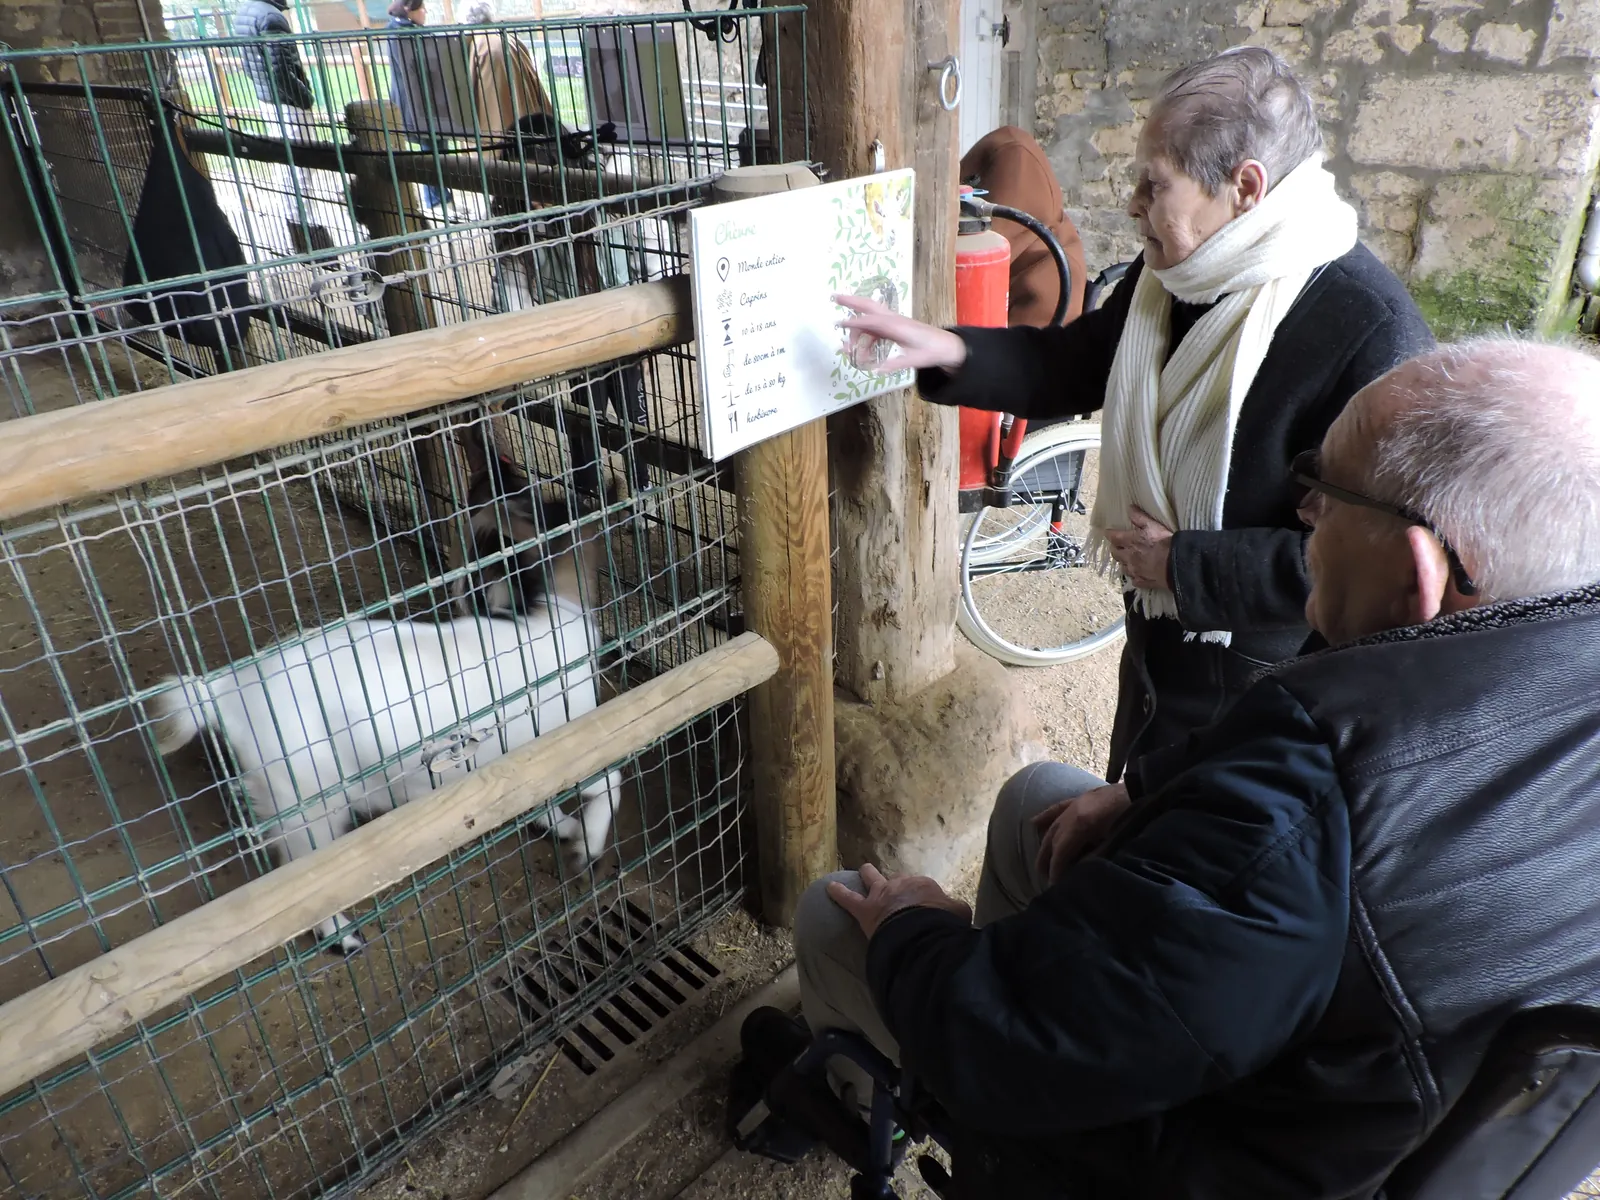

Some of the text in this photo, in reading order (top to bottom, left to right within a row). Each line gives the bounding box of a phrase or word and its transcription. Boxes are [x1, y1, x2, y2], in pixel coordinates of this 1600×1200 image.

[737, 253, 786, 274] Monde entier
[739, 290, 768, 308] Caprins
[764, 320, 777, 329] ans
[743, 353, 752, 366] de
[744, 382, 753, 395] de
[777, 372, 786, 388] kg
[746, 407, 778, 423] herbivore
